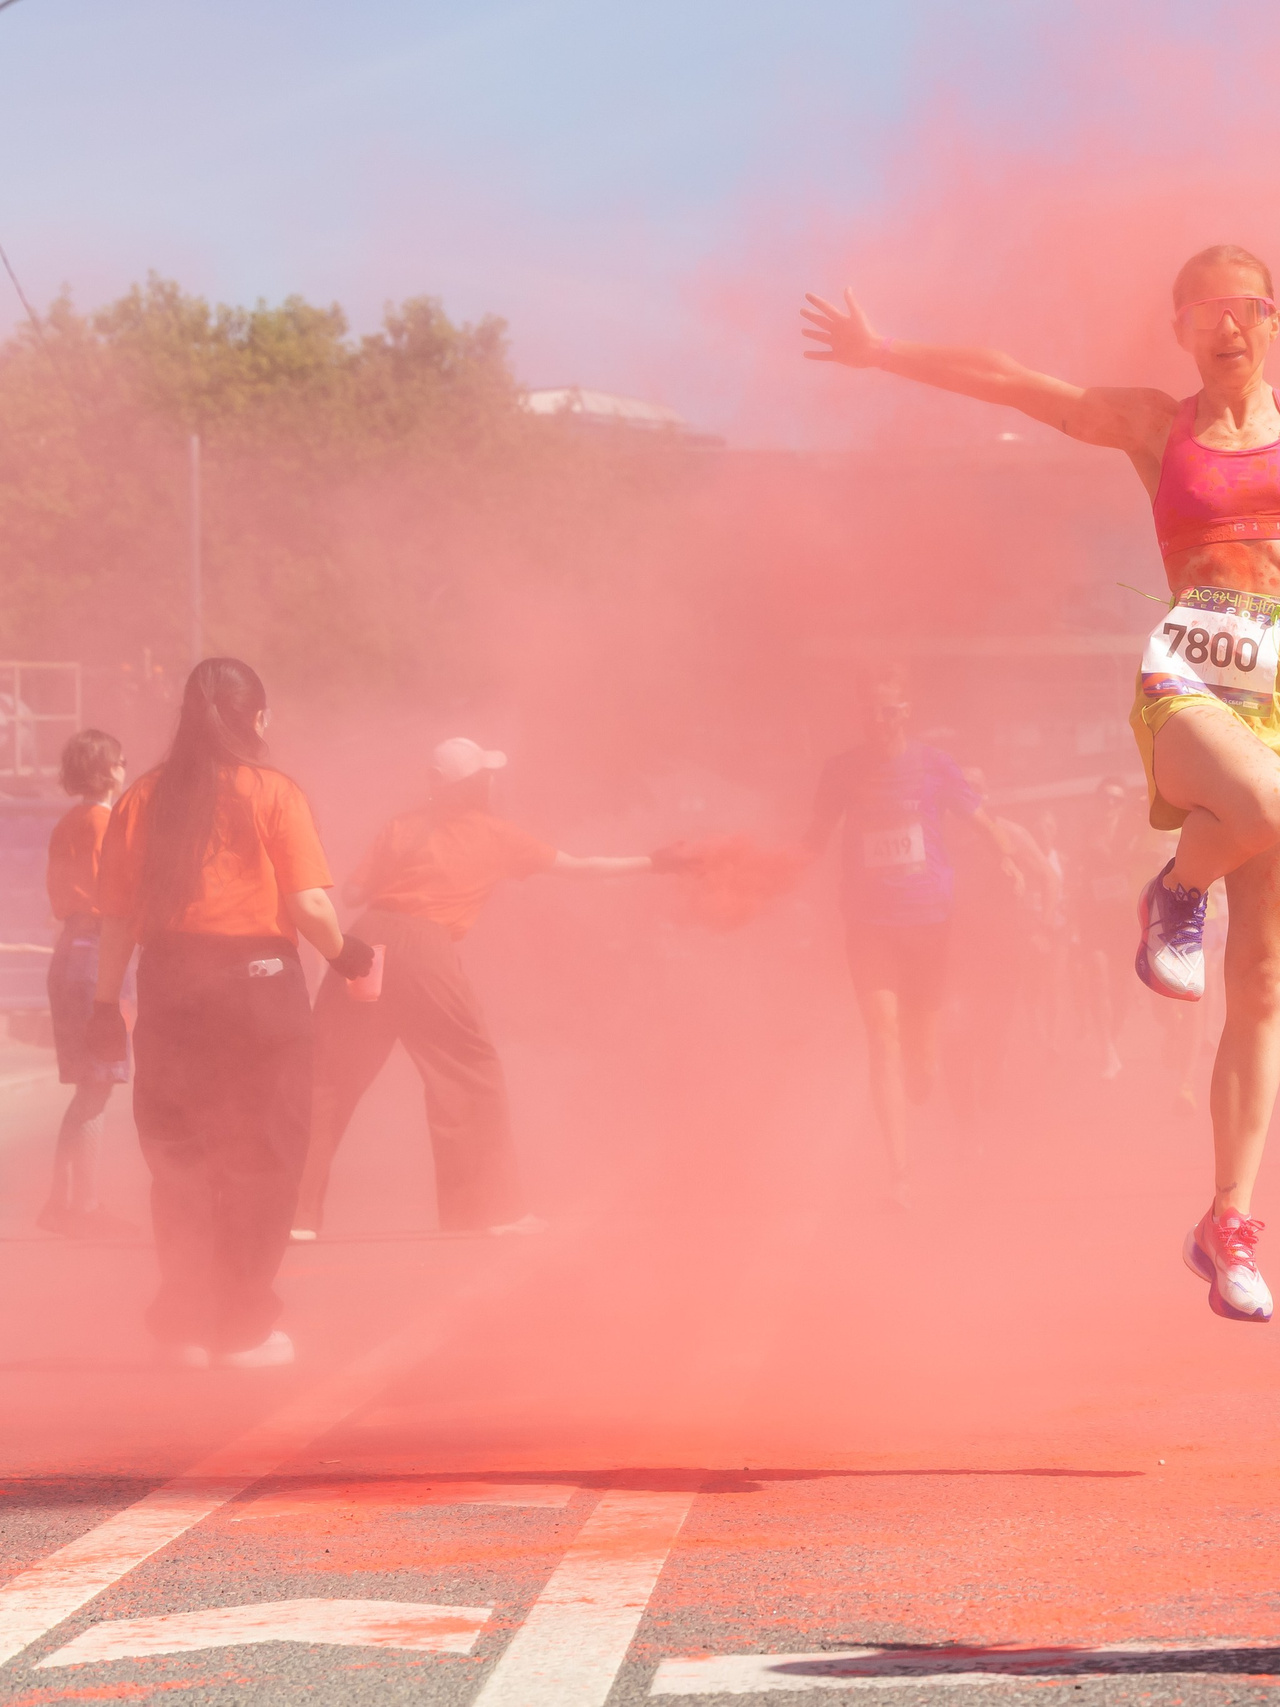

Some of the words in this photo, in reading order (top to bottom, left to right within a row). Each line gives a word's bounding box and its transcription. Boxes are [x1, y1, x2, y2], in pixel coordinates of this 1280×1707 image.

[1180, 588, 1276, 615] РАСОЧНЫЙ
[1226, 607, 1266, 623] 202
[1162, 622, 1260, 672] 7800
